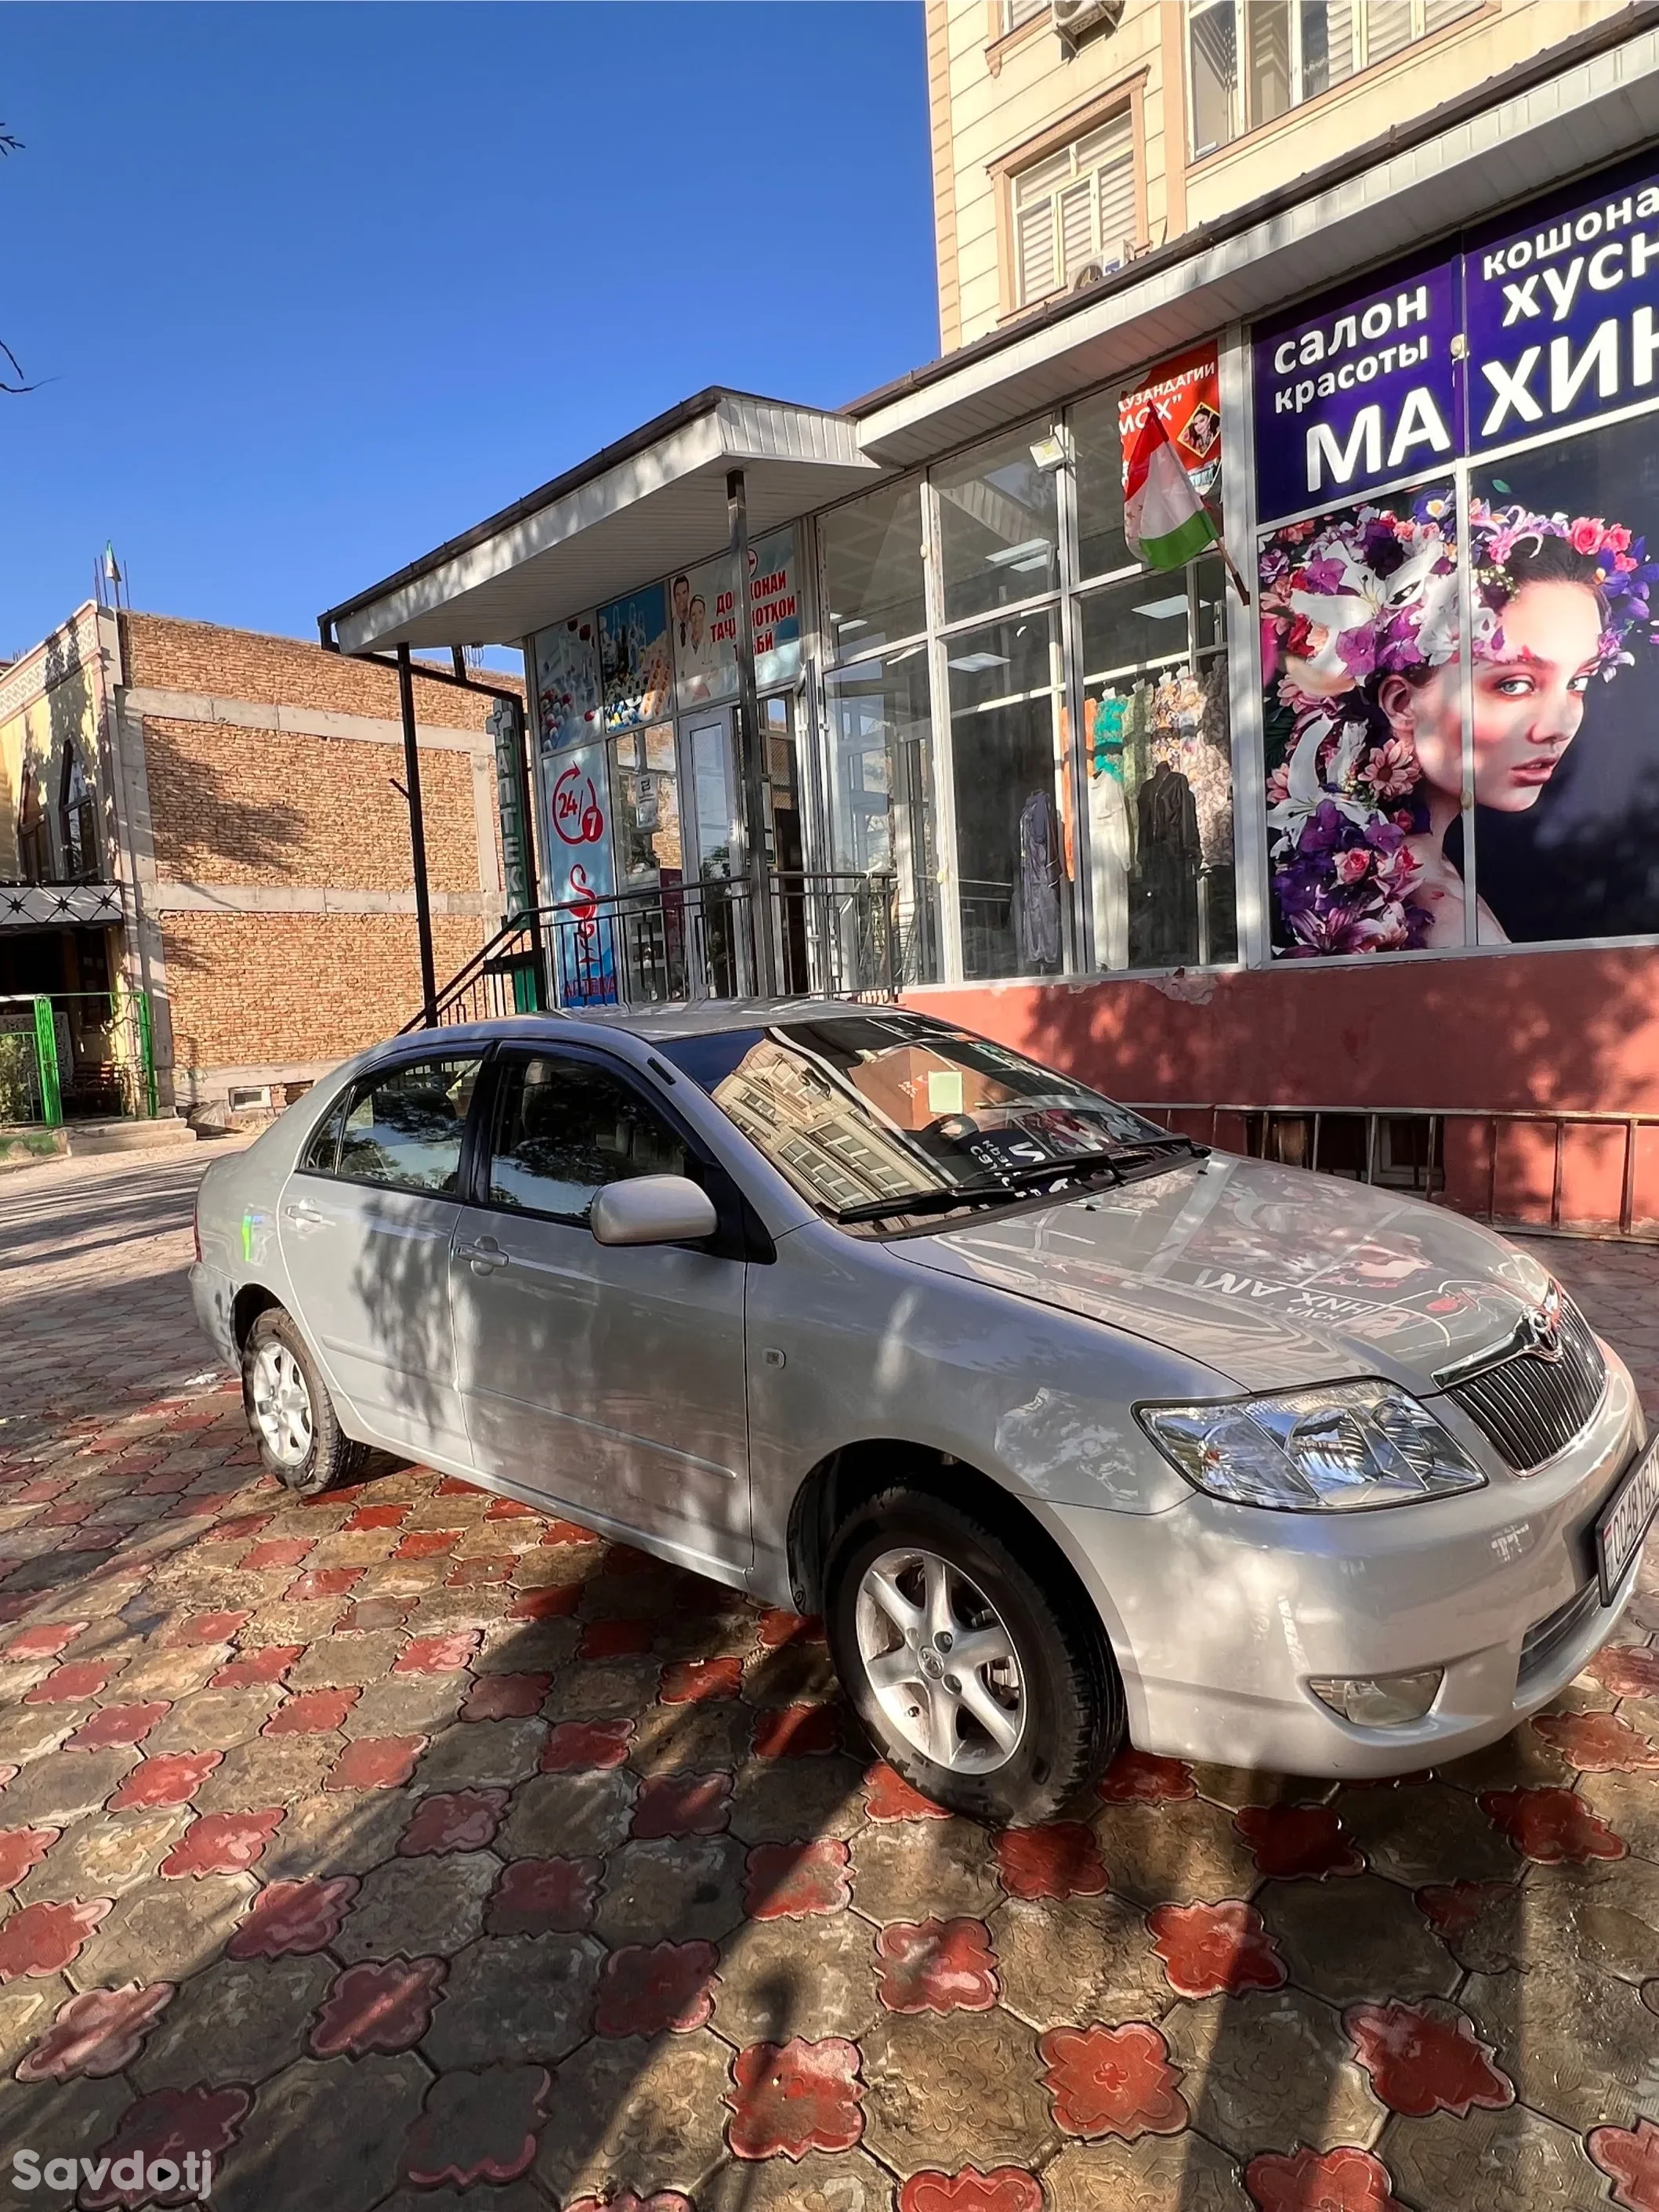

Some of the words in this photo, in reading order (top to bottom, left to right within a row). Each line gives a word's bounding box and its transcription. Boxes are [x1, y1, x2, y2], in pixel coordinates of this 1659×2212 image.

[1274, 285, 1427, 375] салон
[1275, 335, 1428, 414] красоты
[497, 747, 523, 923] АПТЕКА
